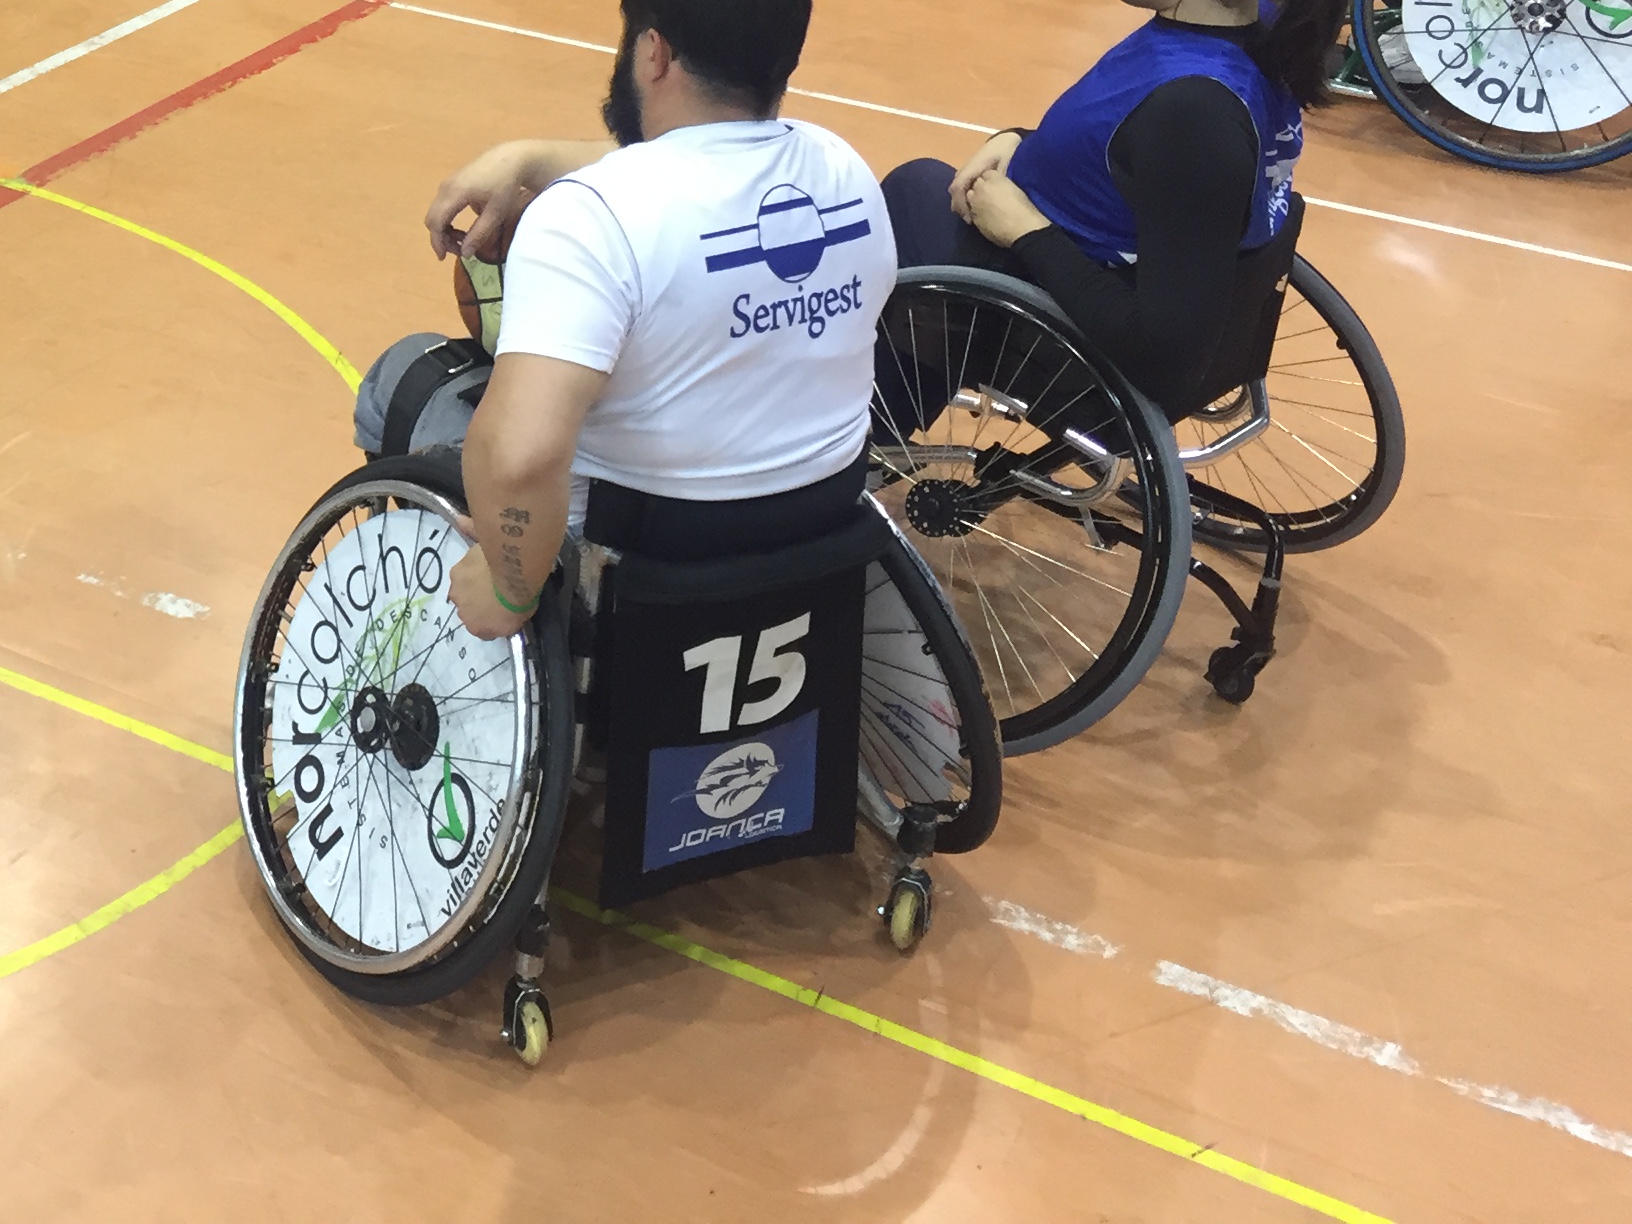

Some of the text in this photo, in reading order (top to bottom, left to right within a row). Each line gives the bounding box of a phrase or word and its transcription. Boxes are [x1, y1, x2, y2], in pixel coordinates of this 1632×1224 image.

[730, 274, 862, 339] Servigest
[291, 529, 451, 862] norcolchó
[682, 611, 811, 734] 15
[668, 807, 786, 853] JOANCA
